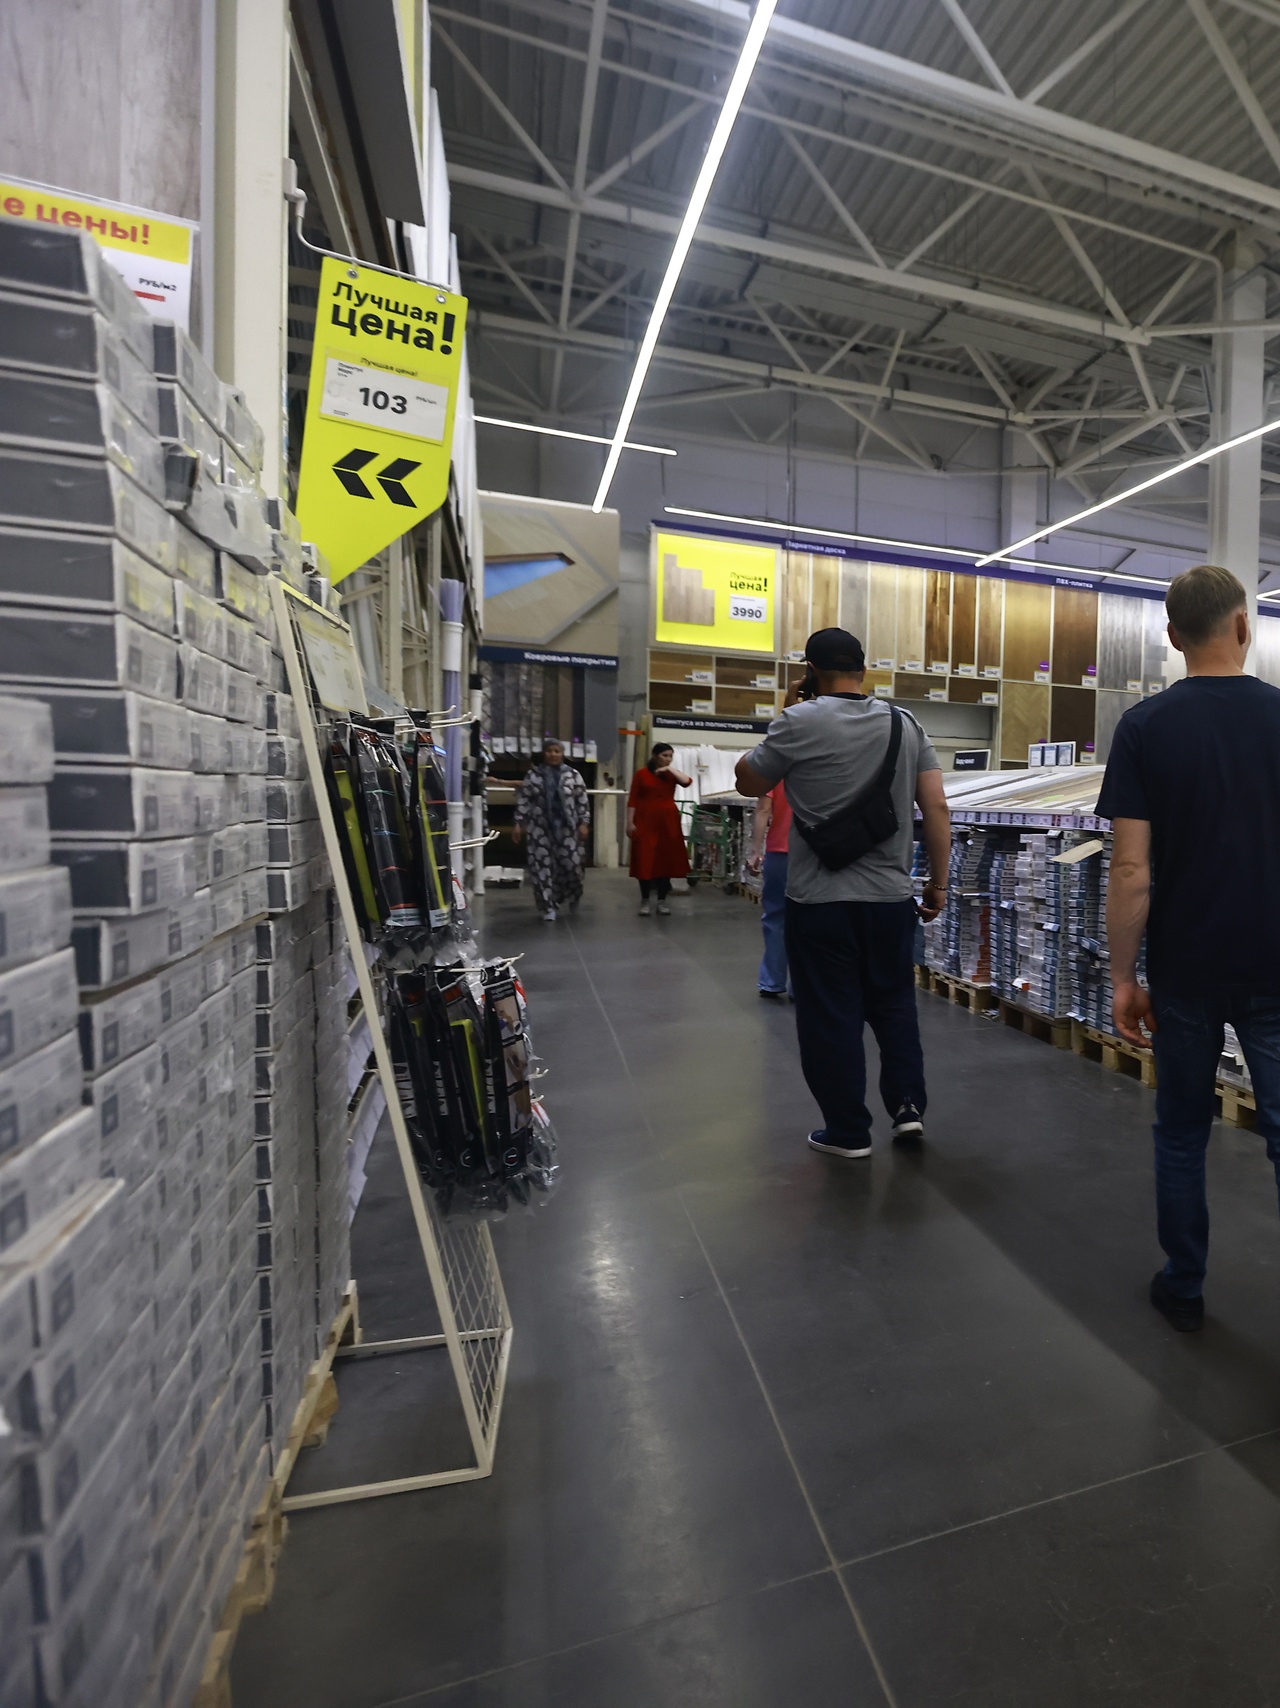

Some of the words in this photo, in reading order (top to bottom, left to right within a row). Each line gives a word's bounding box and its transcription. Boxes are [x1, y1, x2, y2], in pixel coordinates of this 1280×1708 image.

[36, 204, 150, 245] цены!
[332, 281, 438, 325] Лучшая
[331, 304, 456, 355] цена!
[358, 387, 408, 415] 103
[729, 577, 768, 592] цена!
[1055, 577, 1094, 589] ПВХ-плитка
[732, 606, 762, 619] 3990
[524, 651, 570, 663] Ковровые
[570, 656, 617, 667] покрытия
[656, 717, 694, 727] Плинтуса
[706, 720, 753, 731] полистирола
